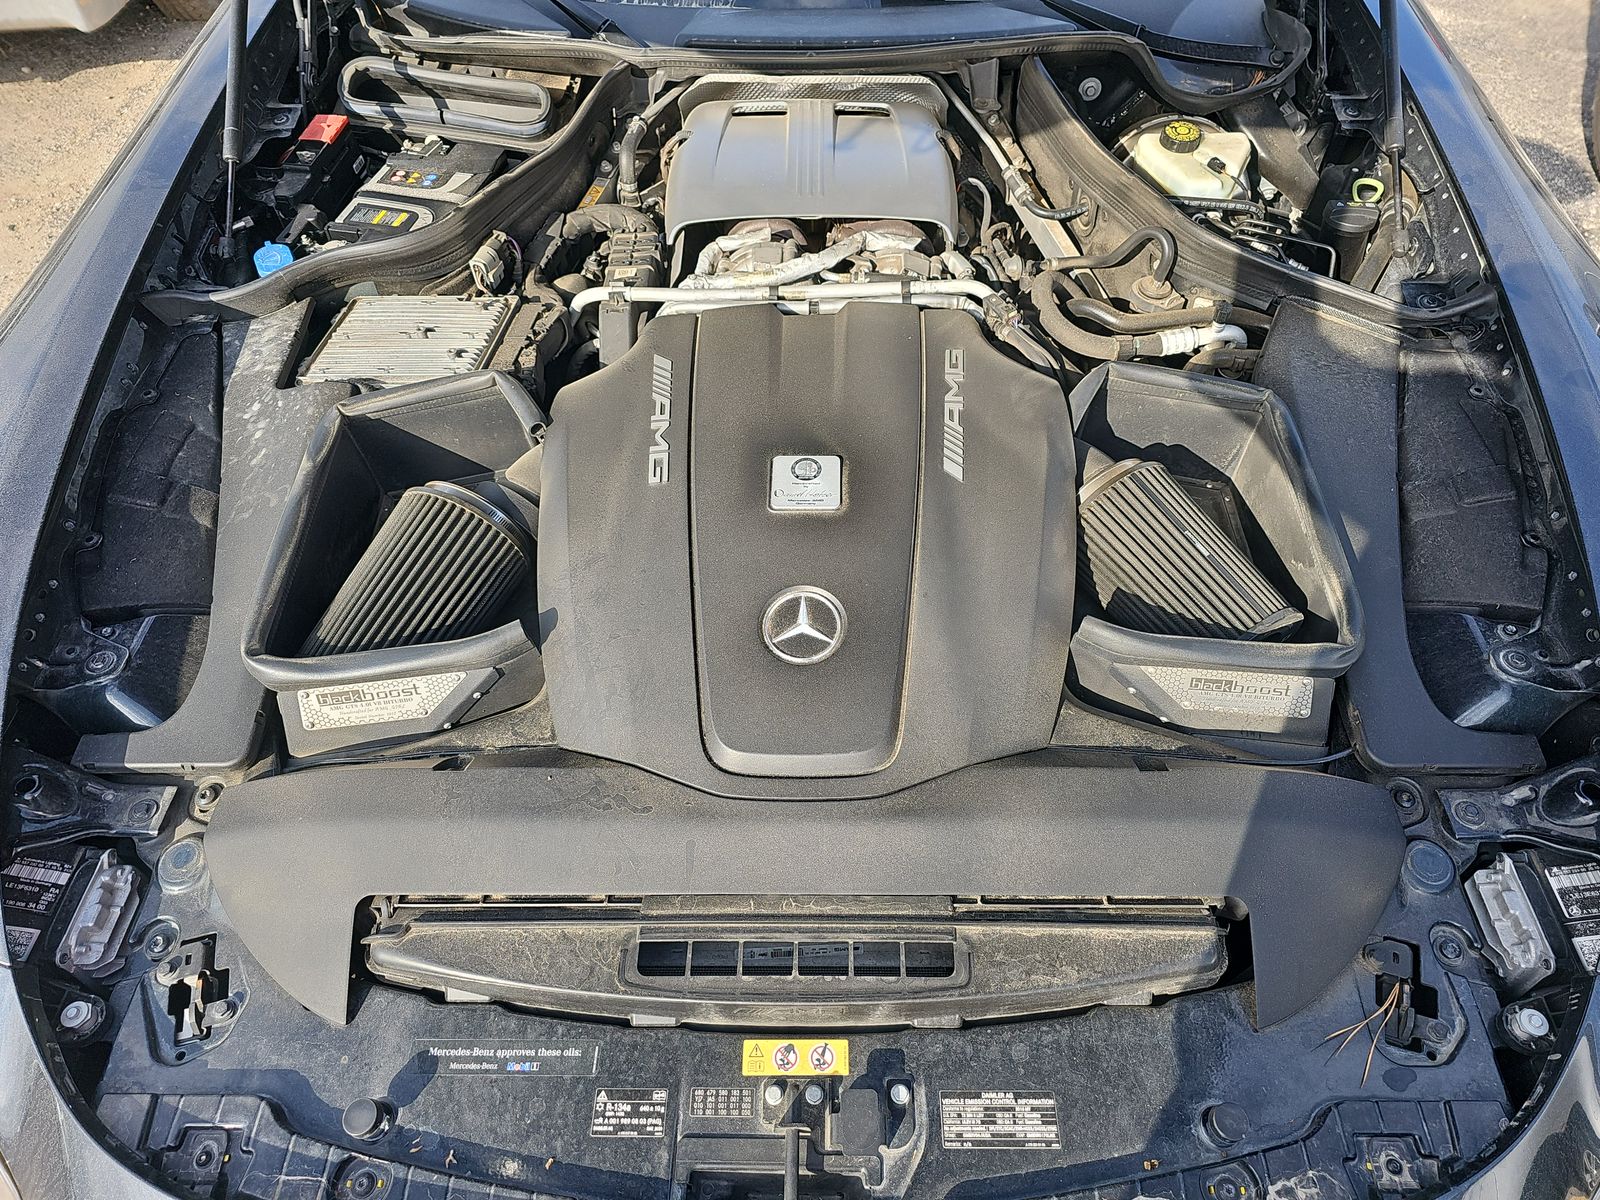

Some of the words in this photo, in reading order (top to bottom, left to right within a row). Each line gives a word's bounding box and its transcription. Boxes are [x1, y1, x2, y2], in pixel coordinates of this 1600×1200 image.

[1190, 677, 1292, 697] blackboost
[316, 683, 422, 707] blackboost
[428, 1047, 495, 1056] Mercedes-Benz
[496, 1048, 536, 1058] approves
[538, 1047, 561, 1056] these
[563, 1047, 582, 1057] oils:
[449, 1062, 498, 1070] Mercedes-Benz
[506, 1062, 531, 1071] Mobil
[606, 1103, 632, 1112] R-134a
